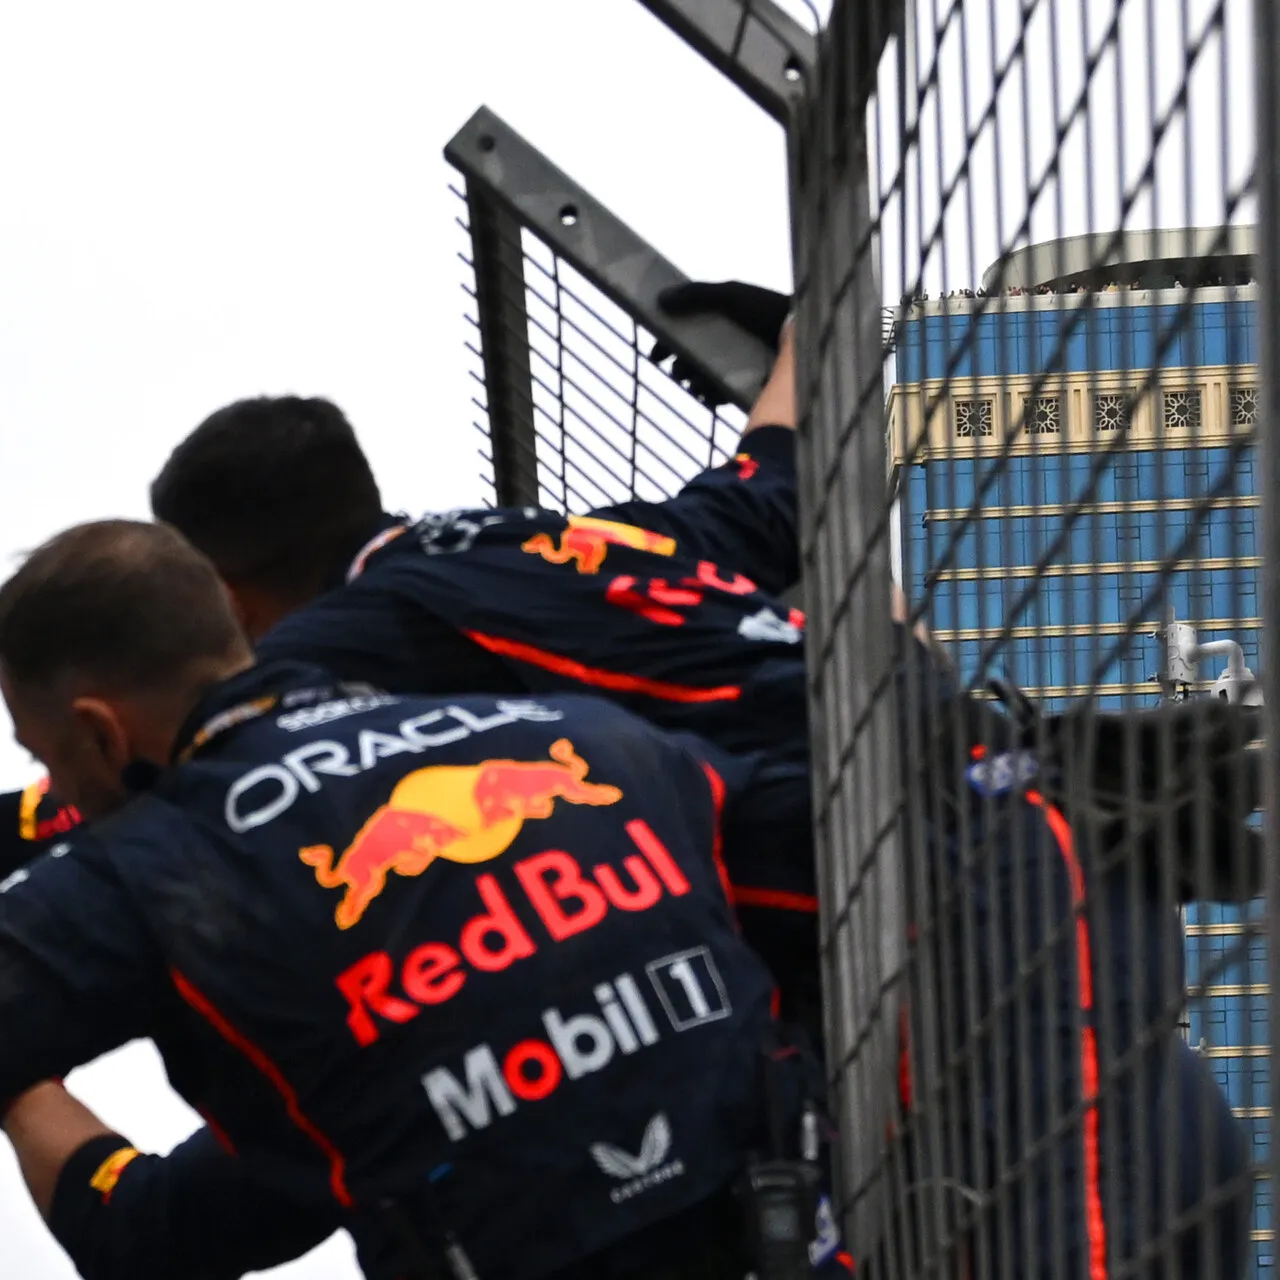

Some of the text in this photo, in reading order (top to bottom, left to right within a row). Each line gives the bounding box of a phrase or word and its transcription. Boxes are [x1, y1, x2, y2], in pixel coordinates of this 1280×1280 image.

[225, 702, 563, 833] ORACLE
[335, 873, 537, 1047] Red
[421, 973, 660, 1142] Mobil
